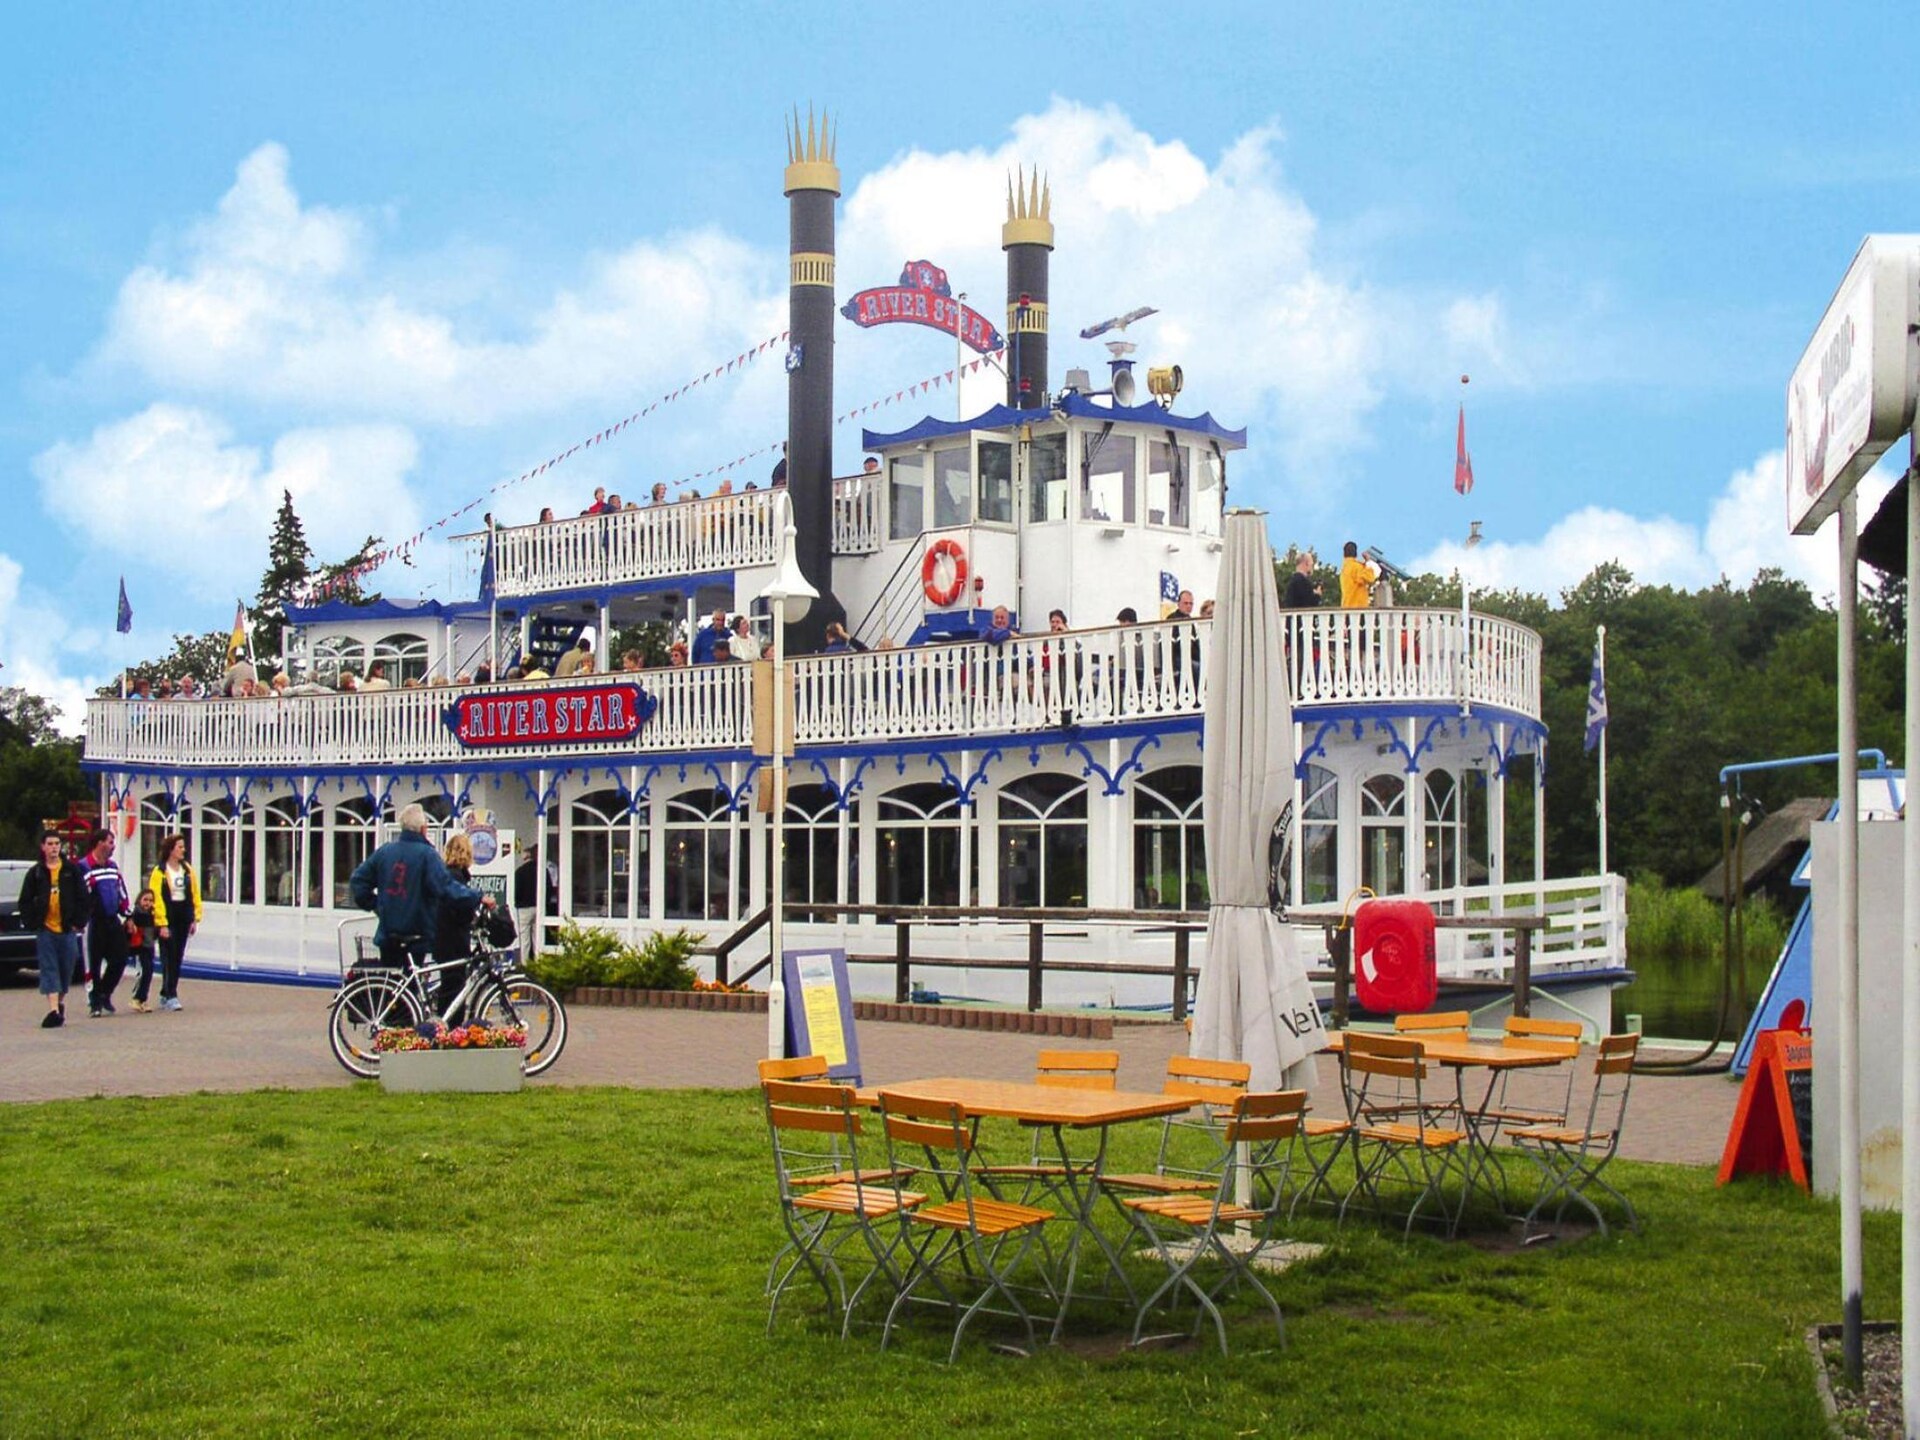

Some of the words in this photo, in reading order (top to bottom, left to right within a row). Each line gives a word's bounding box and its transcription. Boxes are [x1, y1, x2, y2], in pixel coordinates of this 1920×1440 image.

[865, 292, 928, 318] RIVER
[933, 298, 984, 342] STAR
[469, 697, 549, 738] RIVER
[554, 693, 625, 735] STAR
